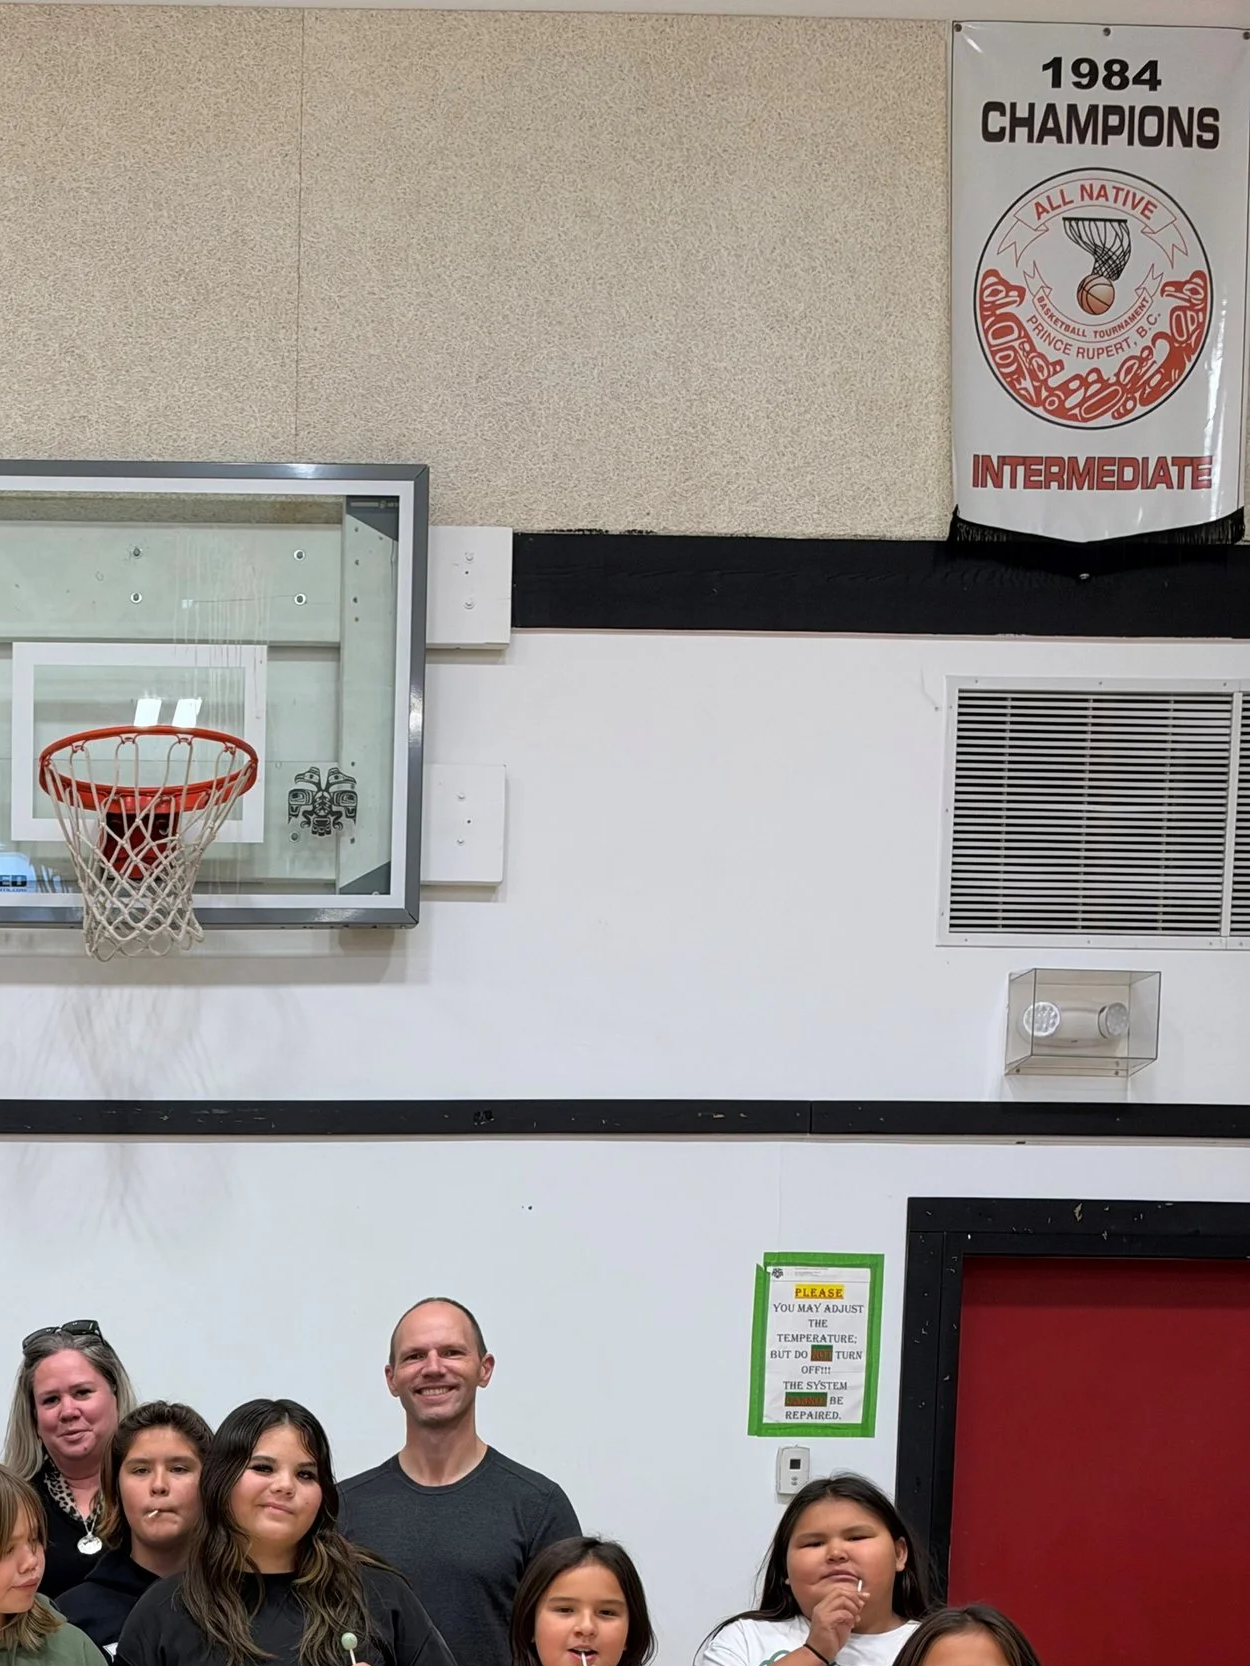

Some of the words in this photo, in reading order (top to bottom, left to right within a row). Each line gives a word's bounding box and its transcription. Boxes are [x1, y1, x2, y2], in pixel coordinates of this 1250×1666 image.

[1041, 57, 1162, 92] 1984
[981, 101, 1220, 149] CHAMPIONS
[1034, 188, 1074, 221] ALL
[1080, 182, 1159, 221] NATIVE
[1036, 296, 1087, 338] BASKETBALL
[1093, 297, 1149, 339] TOURNAMENT
[1027, 315, 1073, 356] PRINCE
[1075, 337, 1138, 360] RUPERT,
[1135, 312, 1161, 339] B.C.
[972, 453, 1213, 491] INTERMEDIATE
[795, 1287, 844, 1299] PLEASE
[773, 1302, 794, 1313] YOU
[797, 1302, 822, 1313] MAY
[823, 1304, 864, 1314] ADJUST
[808, 1318, 828, 1328] THE
[777, 1333, 857, 1344] TEMPERATURE;
[770, 1350, 791, 1359] BUT
[794, 1350, 808, 1359] DO
[835, 1350, 863, 1360] TURN
[801, 1365, 831, 1374] OFF!!!
[783, 1380, 804, 1390] THE
[806, 1380, 848, 1390] SYSTEM
[830, 1396, 843, 1405] BE
[785, 1411, 842, 1420] REPAIRED.
